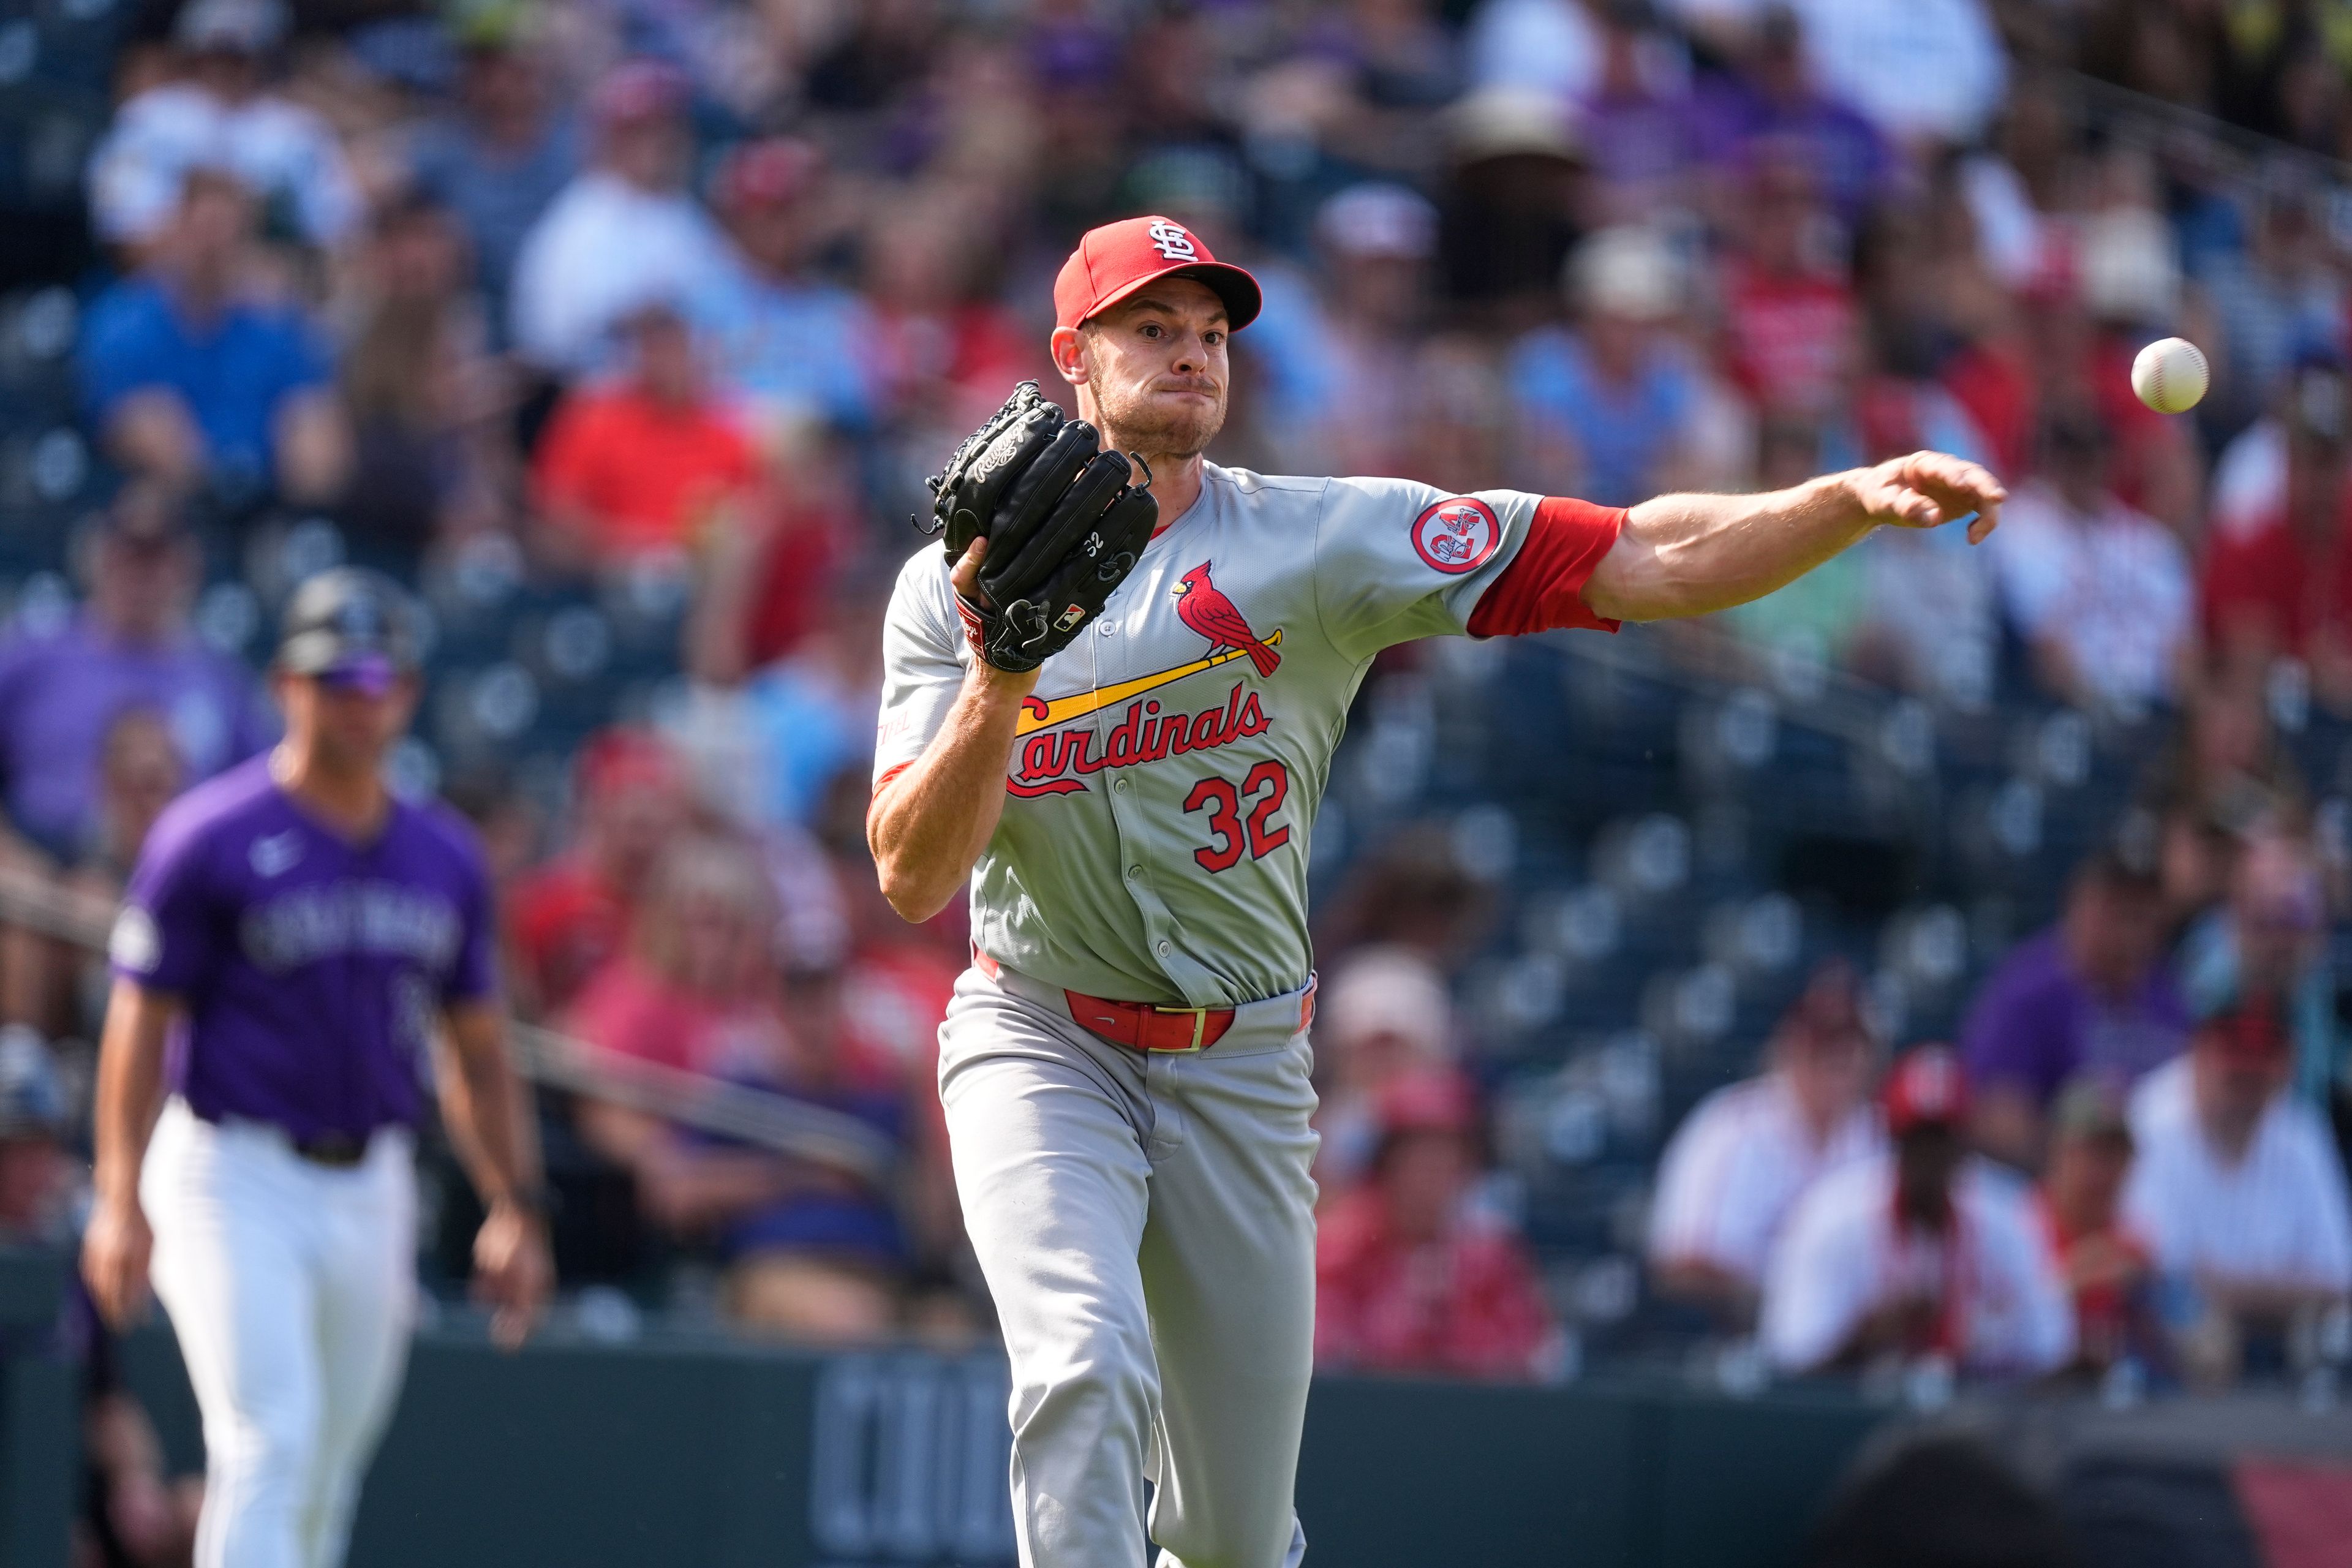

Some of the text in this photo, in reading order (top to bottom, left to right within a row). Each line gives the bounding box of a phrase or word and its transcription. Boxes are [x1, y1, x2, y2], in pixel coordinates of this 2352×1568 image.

[973, 421, 1026, 483] Rawlings
[1430, 513, 1480, 559] 24
[1183, 758, 1290, 874] 32
